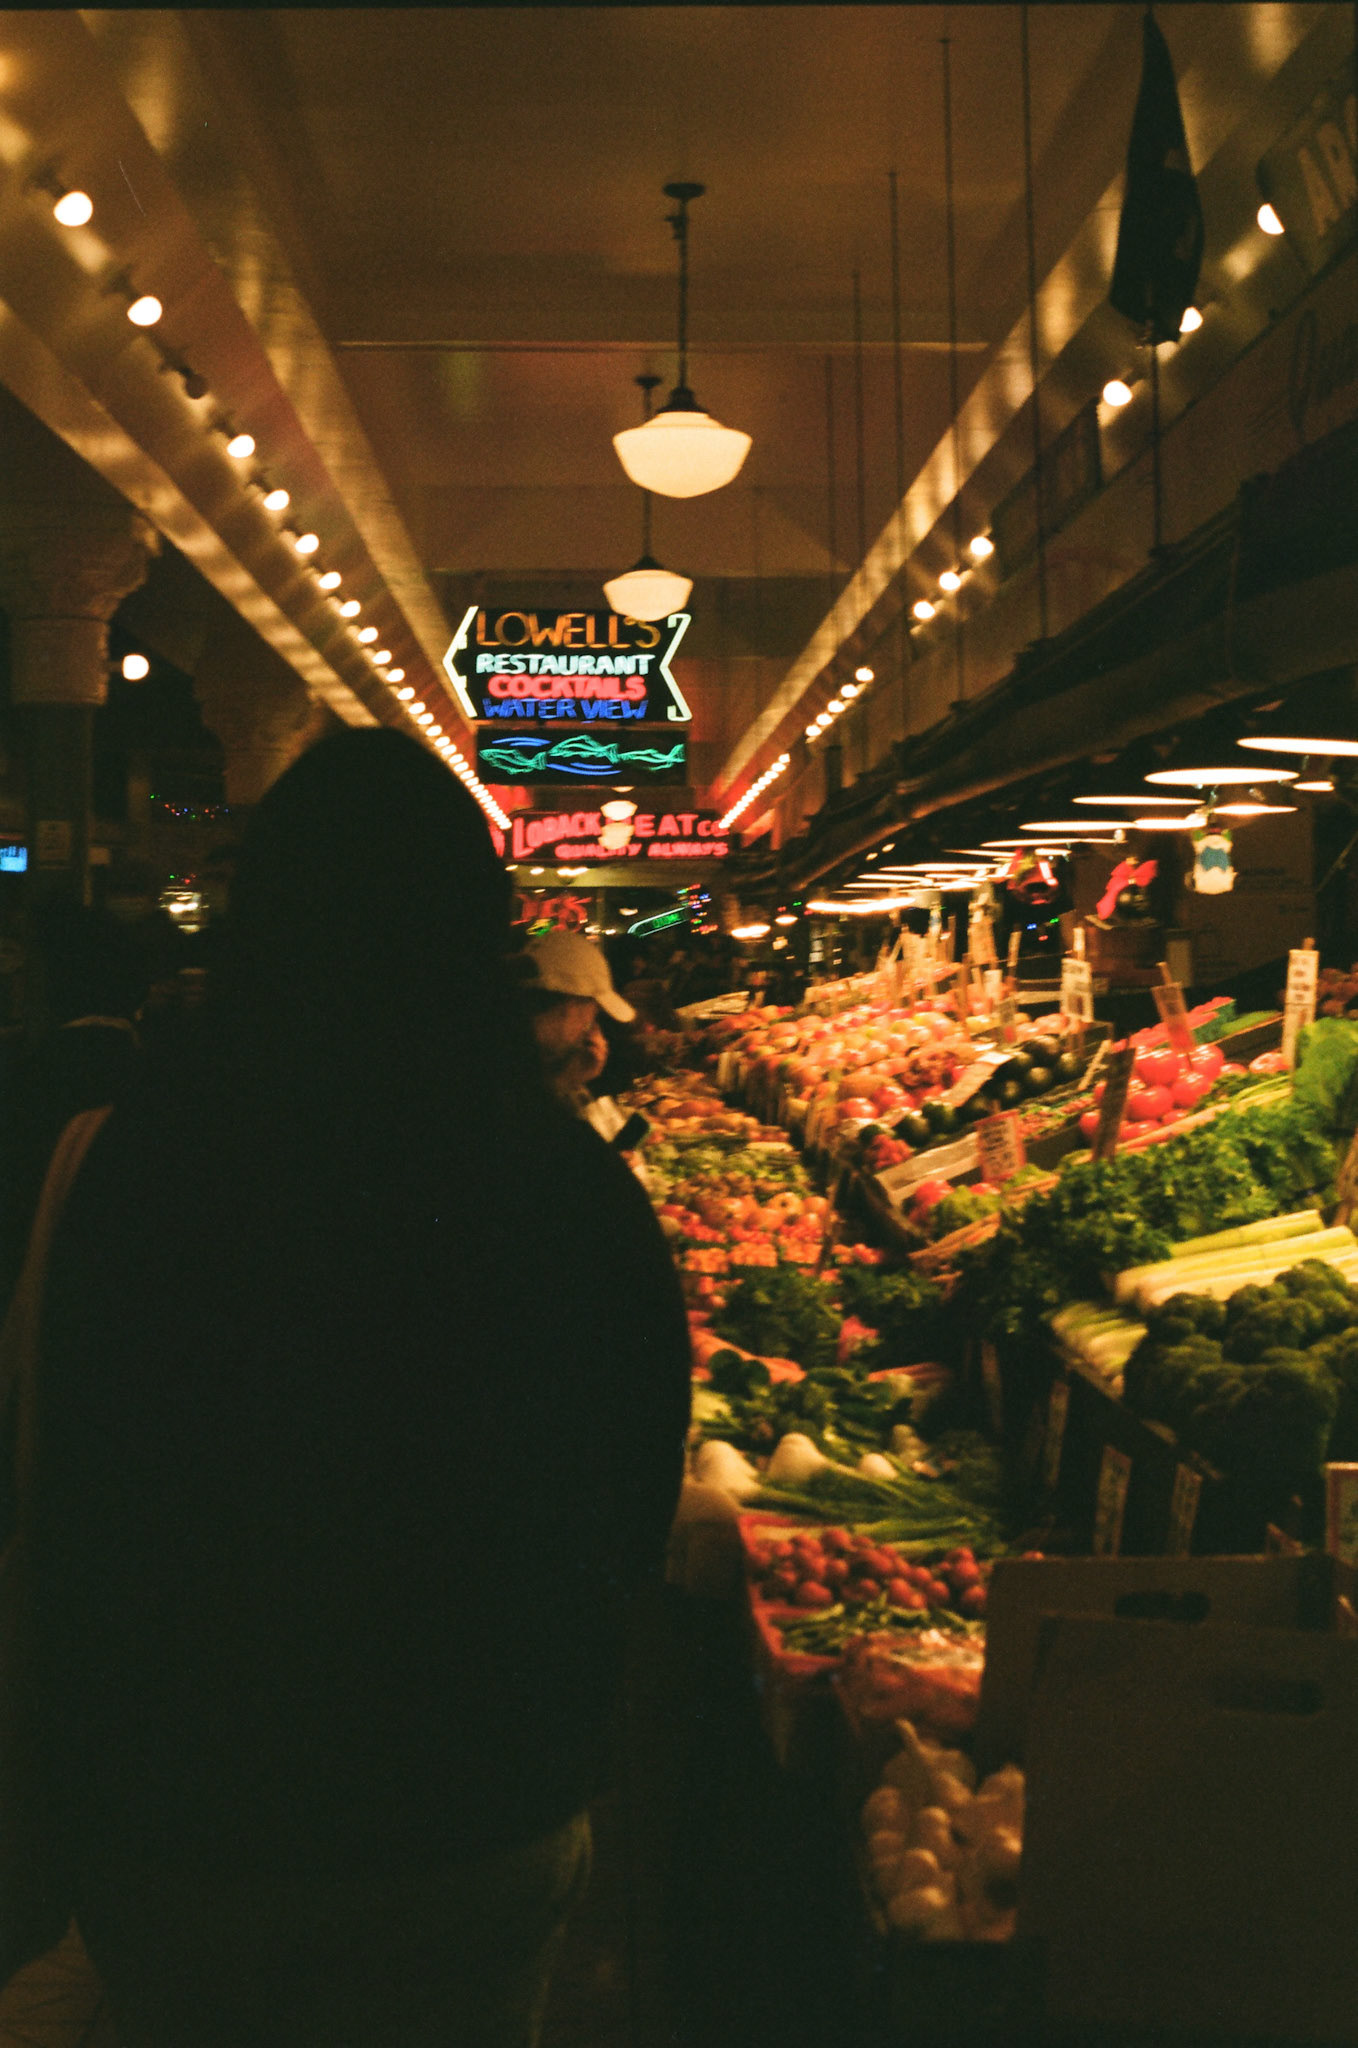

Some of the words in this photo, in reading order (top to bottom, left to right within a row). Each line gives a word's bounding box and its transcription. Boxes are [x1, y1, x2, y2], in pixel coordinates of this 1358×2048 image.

[476, 611, 661, 649] LOWELL'S
[475, 653, 656, 676] RESTAURANT
[487, 674, 647, 700] COCKTAILS
[482, 698, 577, 719] WATER
[580, 699, 649, 720] VIEW
[647, 841, 729, 858] ALWAYS
